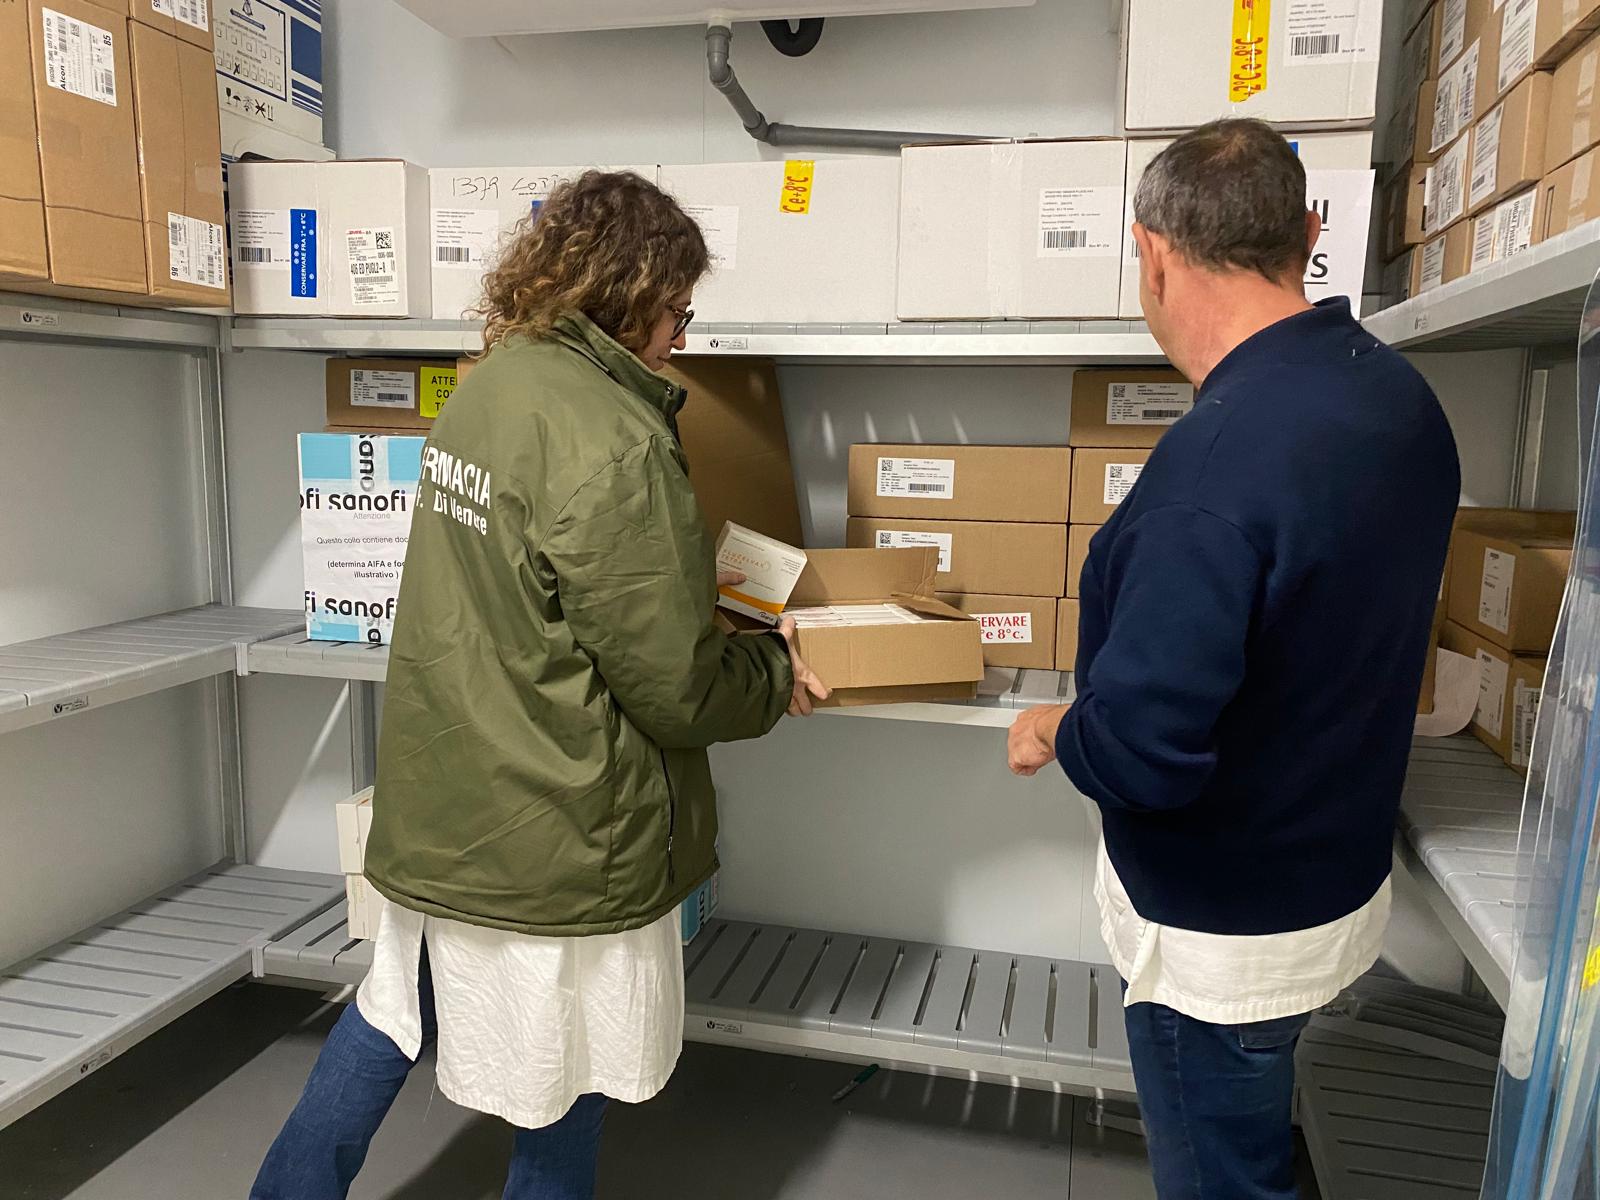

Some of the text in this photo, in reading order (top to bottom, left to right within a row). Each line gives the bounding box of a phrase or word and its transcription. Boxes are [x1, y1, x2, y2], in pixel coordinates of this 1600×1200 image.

[103, 34, 112, 46] 85
[171, 266, 179, 277] 86
[436, 389, 453, 399] CO
[421, 446, 491, 510] RMACIA
[328, 490, 407, 512] sanofi
[433, 489, 448, 515] Di
[353, 512, 391, 520] Attenzione
[316, 536, 343, 545] Questo
[362, 536, 393, 544] contiene
[327, 560, 366, 569] (determina
[367, 560, 386, 568] AIFA
[354, 571, 394, 579] illustrativo
